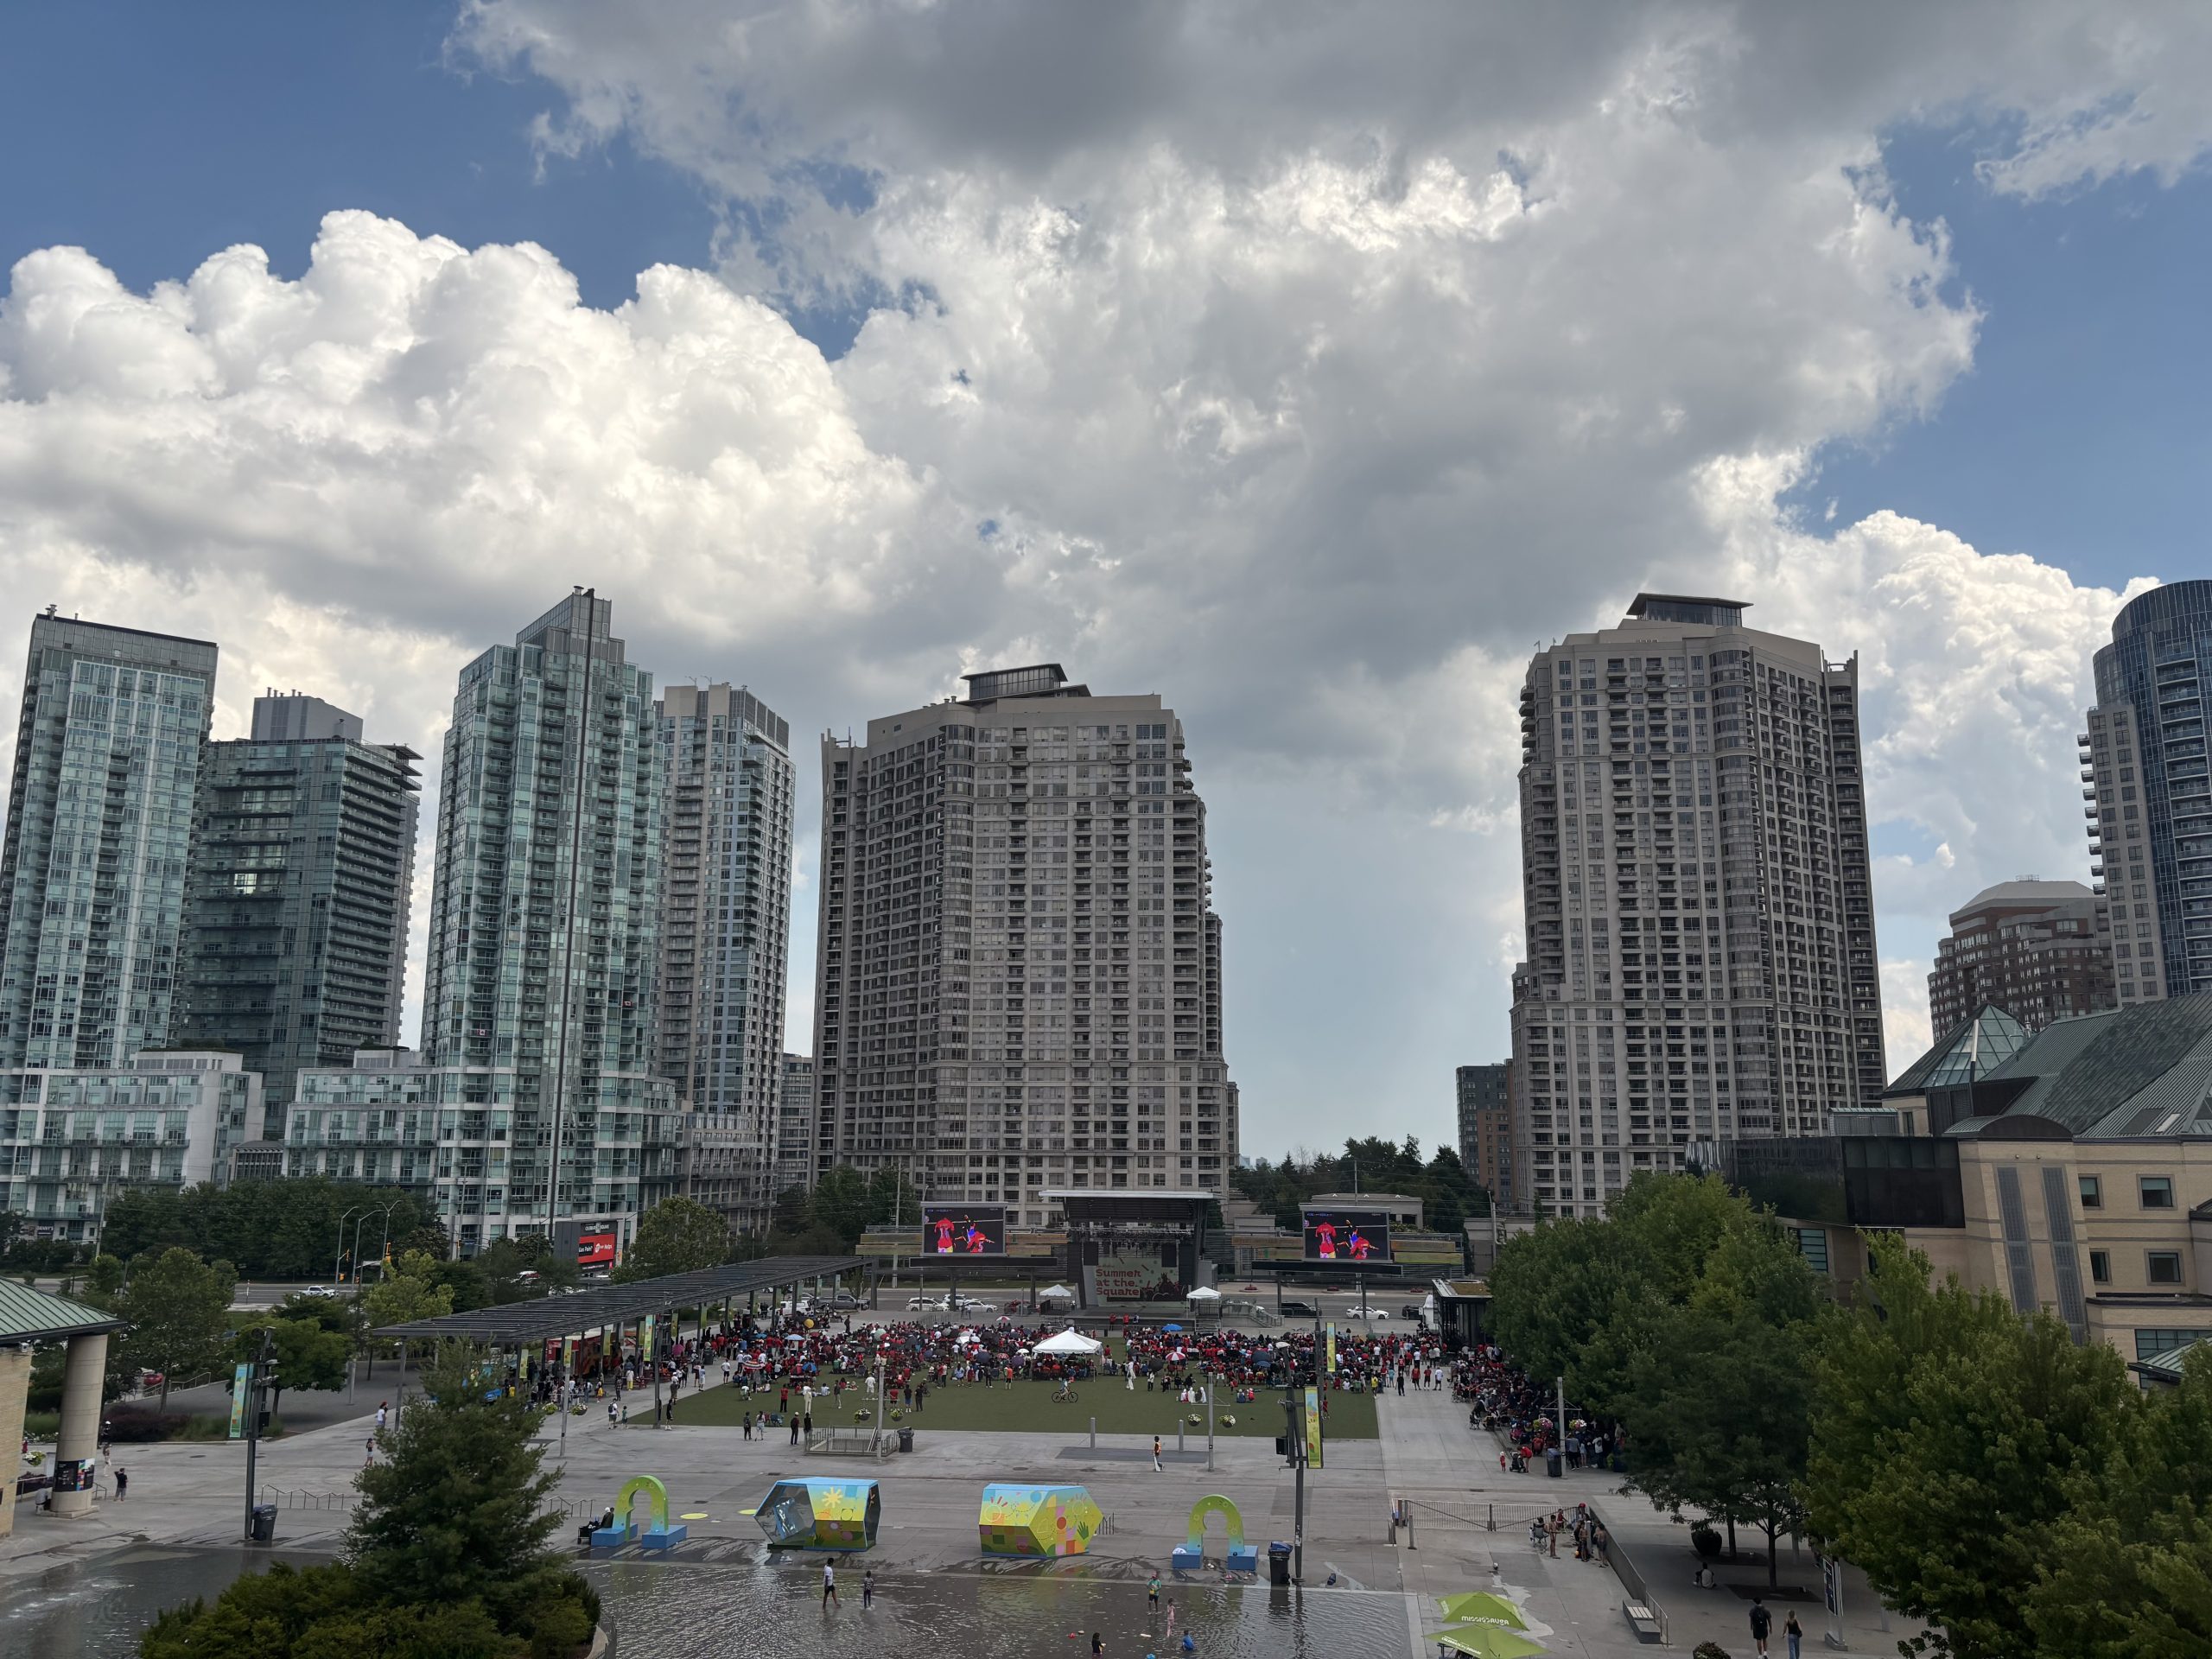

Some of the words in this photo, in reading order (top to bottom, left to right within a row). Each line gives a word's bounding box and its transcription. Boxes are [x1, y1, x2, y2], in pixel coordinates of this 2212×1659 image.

[1096, 1268, 1141, 1277] Summer
[1113, 1278, 1135, 1287] the
[1096, 1287, 1140, 1297] Square
